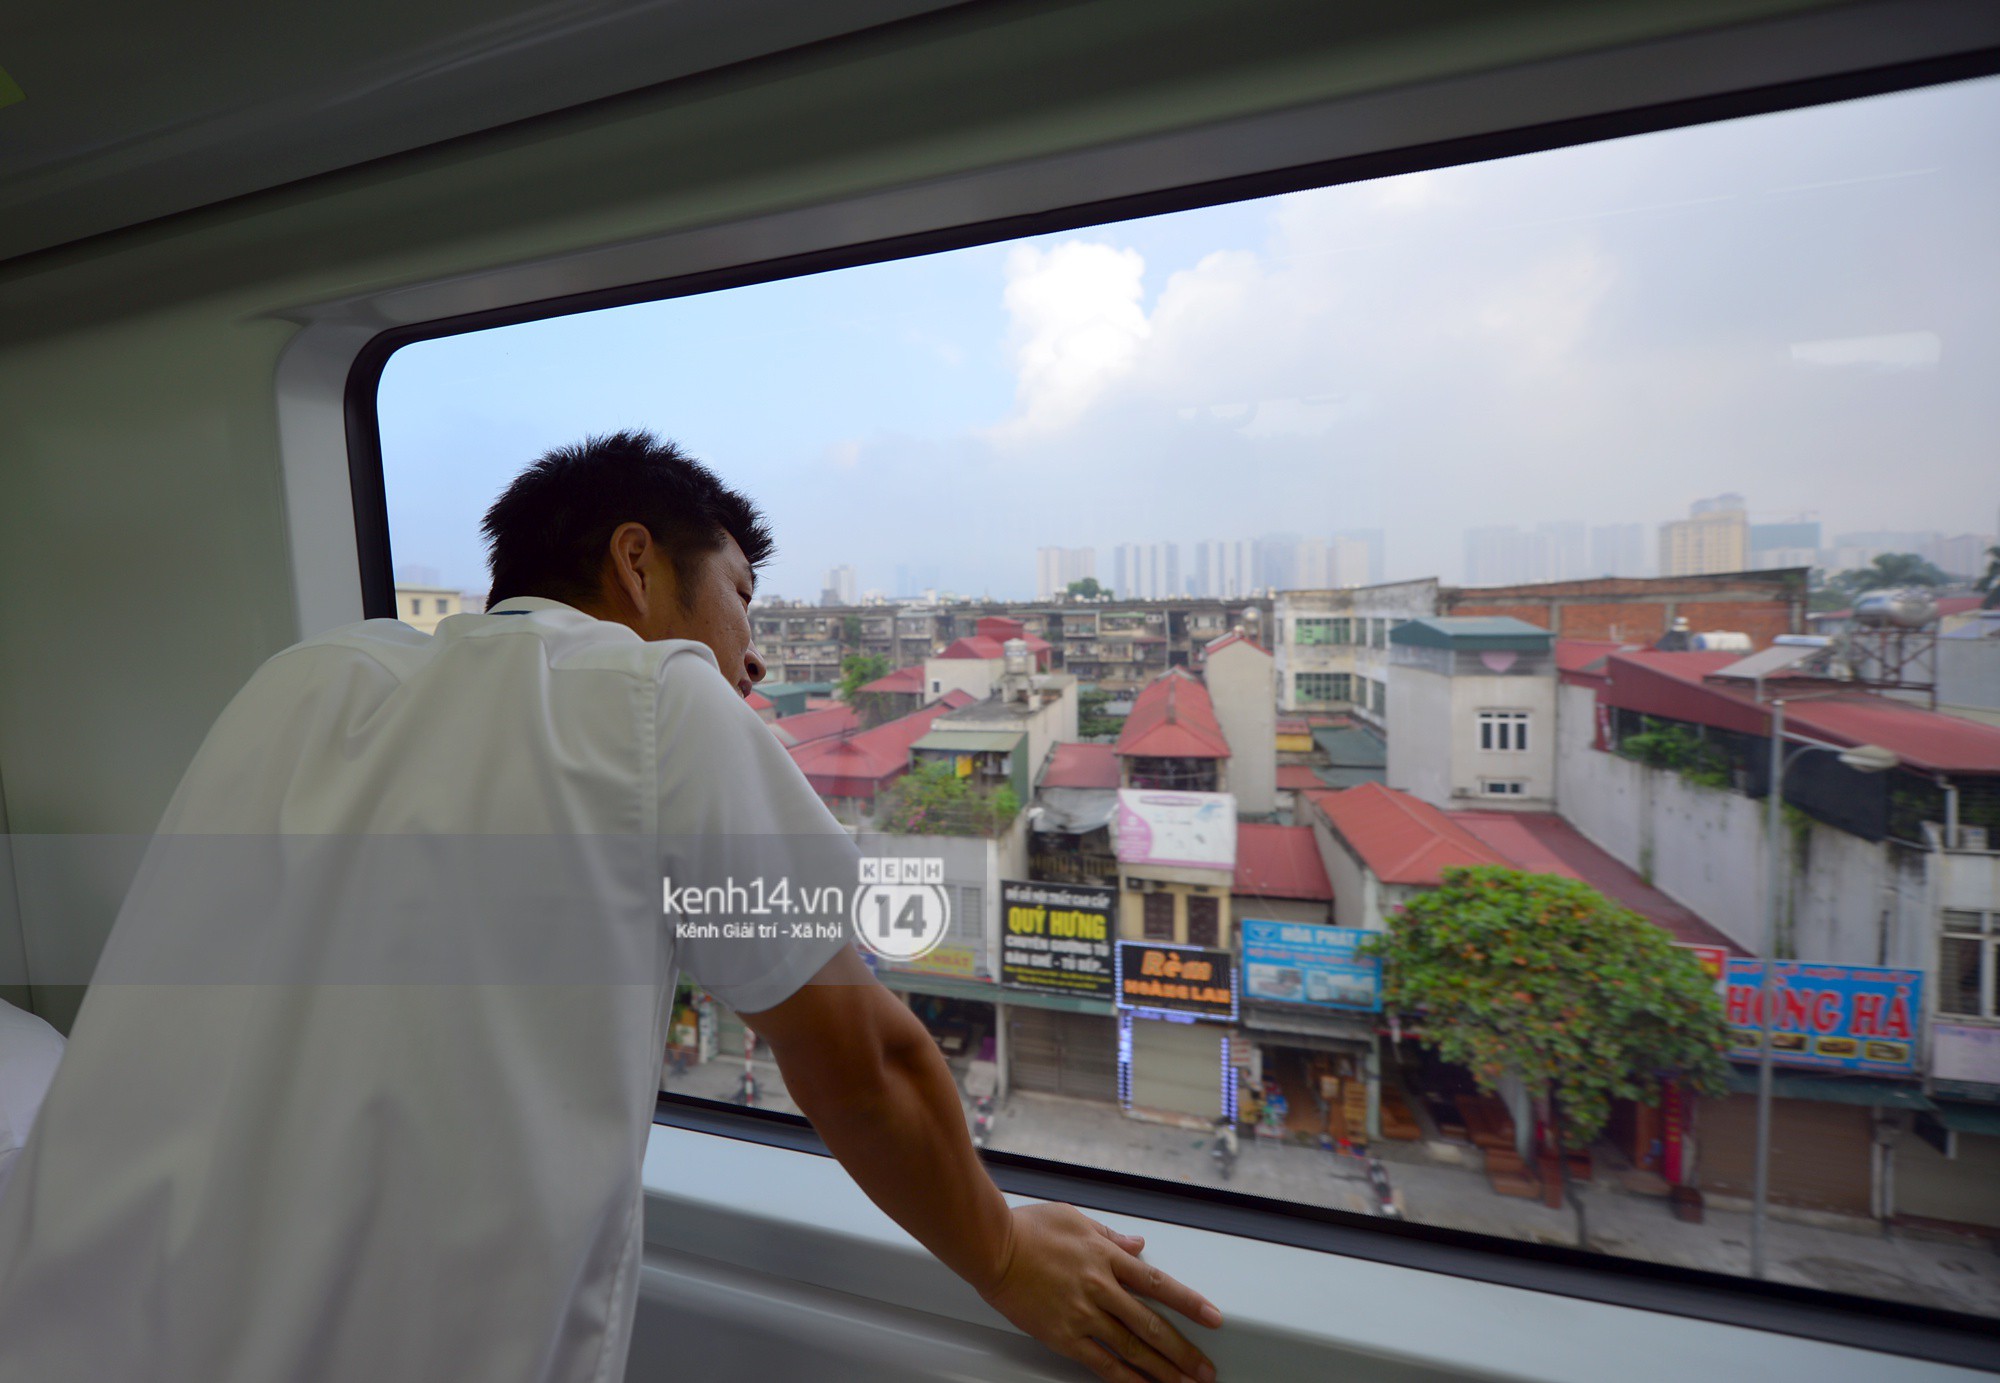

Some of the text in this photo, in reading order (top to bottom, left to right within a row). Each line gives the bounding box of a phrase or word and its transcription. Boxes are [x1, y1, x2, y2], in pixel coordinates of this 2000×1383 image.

[1008, 904, 1107, 940] QUÝ HƯNG
[1141, 950, 1213, 982] Rèm
[1124, 979, 1189, 1000] HOÀNG
[1191, 986, 1231, 1003] LAN
